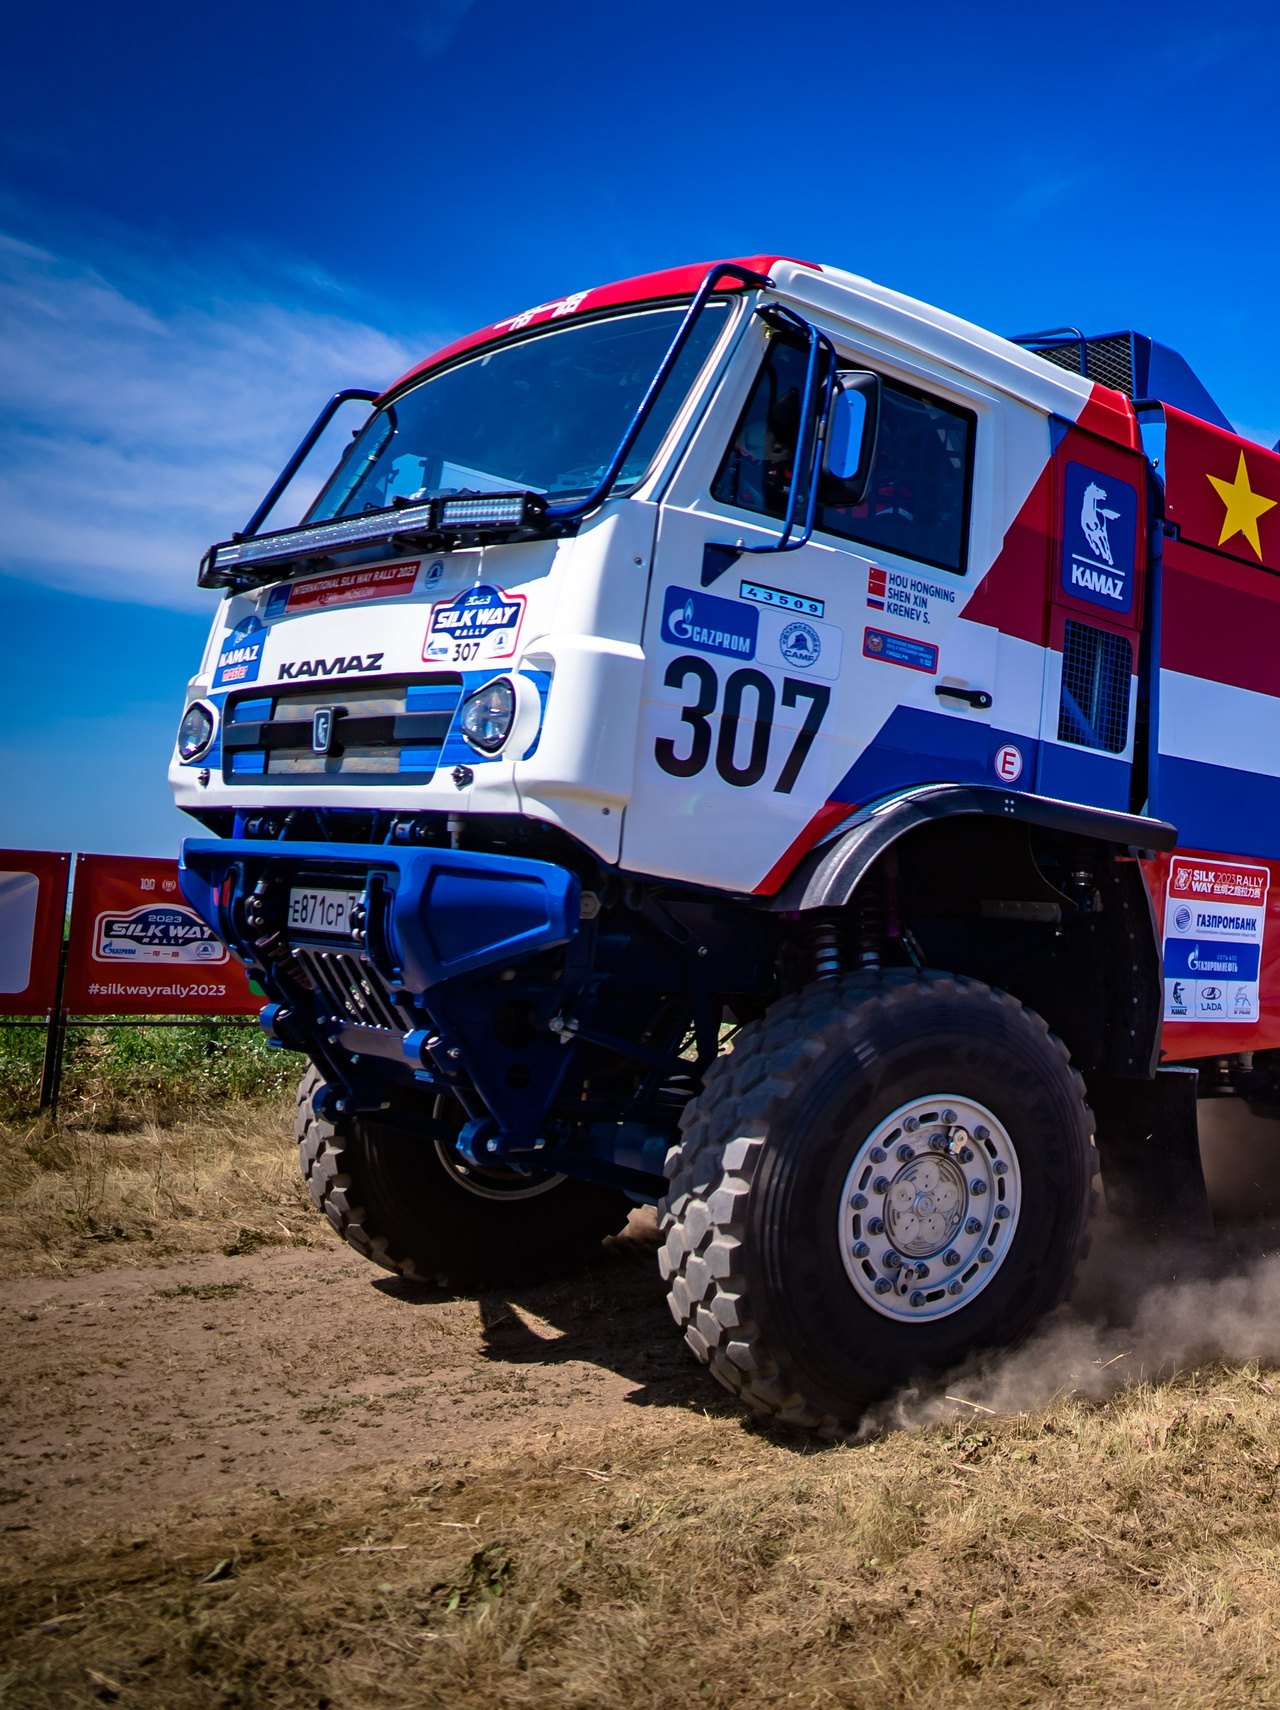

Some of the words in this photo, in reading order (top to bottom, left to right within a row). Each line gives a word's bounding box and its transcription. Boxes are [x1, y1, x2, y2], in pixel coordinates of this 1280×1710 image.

[292, 578, 339, 595] INTERNATIONAL
[340, 576, 355, 587] SILK
[356, 573, 372, 584] WAY
[373, 569, 397, 581] RALLY
[397, 565, 417, 578] 2023
[889, 573, 908, 588] HOU
[910, 579, 955, 603] HONGNING
[1071, 563, 1123, 600] KAMAZ
[747, 588, 818, 612] 43509
[887, 587, 911, 604] SHEN
[912, 594, 928, 609] XIN
[434, 609, 477, 629] SILK
[475, 606, 518, 625] WAY
[886, 601, 921, 621] KRENEV
[922, 612, 930, 624] S.
[454, 628, 488, 637] RALLY
[692, 625, 751, 654] GAZPROM
[219, 645, 260, 667] KAMAZ
[452, 642, 480, 662] 307
[784, 650, 814, 661] CAMF
[278, 652, 384, 680] KAMAZ
[655, 655, 831, 794] 307
[1001, 751, 1016, 775] E
[1192, 881, 1214, 893] WAY
[1193, 869, 1215, 882] SILK
[1216, 872, 1236, 885] 2023
[1236, 875, 1264, 888] RALLY
[148, 915, 182, 923] 2023
[292, 894, 344, 926] E871CP
[109, 923, 165, 937] SILK
[169, 925, 212, 939] WAY
[1197, 913, 1257, 931] ГАЗПРОМБАНК
[88, 983, 226, 997] #silkwayrally2023
[1201, 1003, 1222, 1011] LADA
